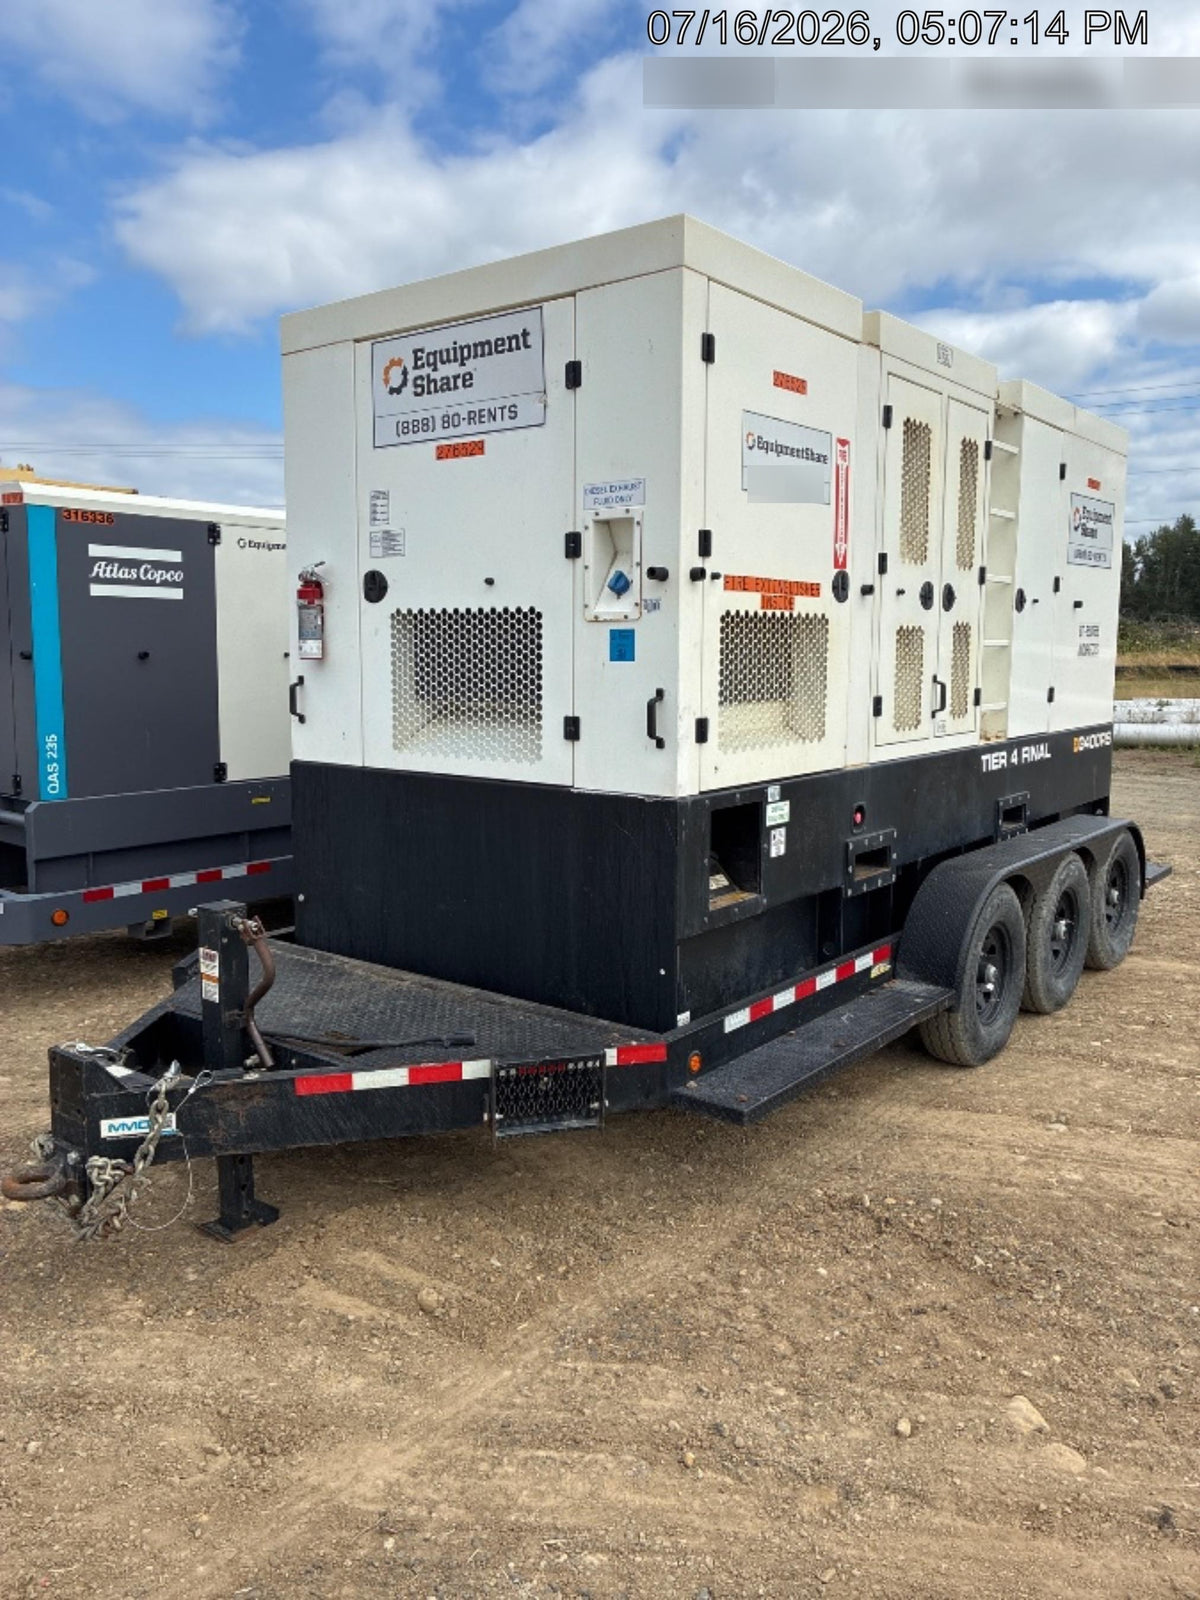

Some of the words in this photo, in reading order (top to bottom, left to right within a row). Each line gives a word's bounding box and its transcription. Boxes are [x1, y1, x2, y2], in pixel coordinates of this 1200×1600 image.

[412, 328, 532, 372] Equipment
[412, 370, 474, 397] Share
[395, 415, 436, 437] (888)
[442, 403, 518, 430] 80-RENTS
[63, 508, 115, 525] 316336
[89, 561, 138, 580] Atlas
[140, 563, 184, 584] Copco
[45, 734, 58, 759] 235
[981, 751, 1008, 773] TIER
[1010, 748, 1018, 766] 4
[1022, 742, 1052, 764] FINAL
[47, 762, 59, 794] QAS
